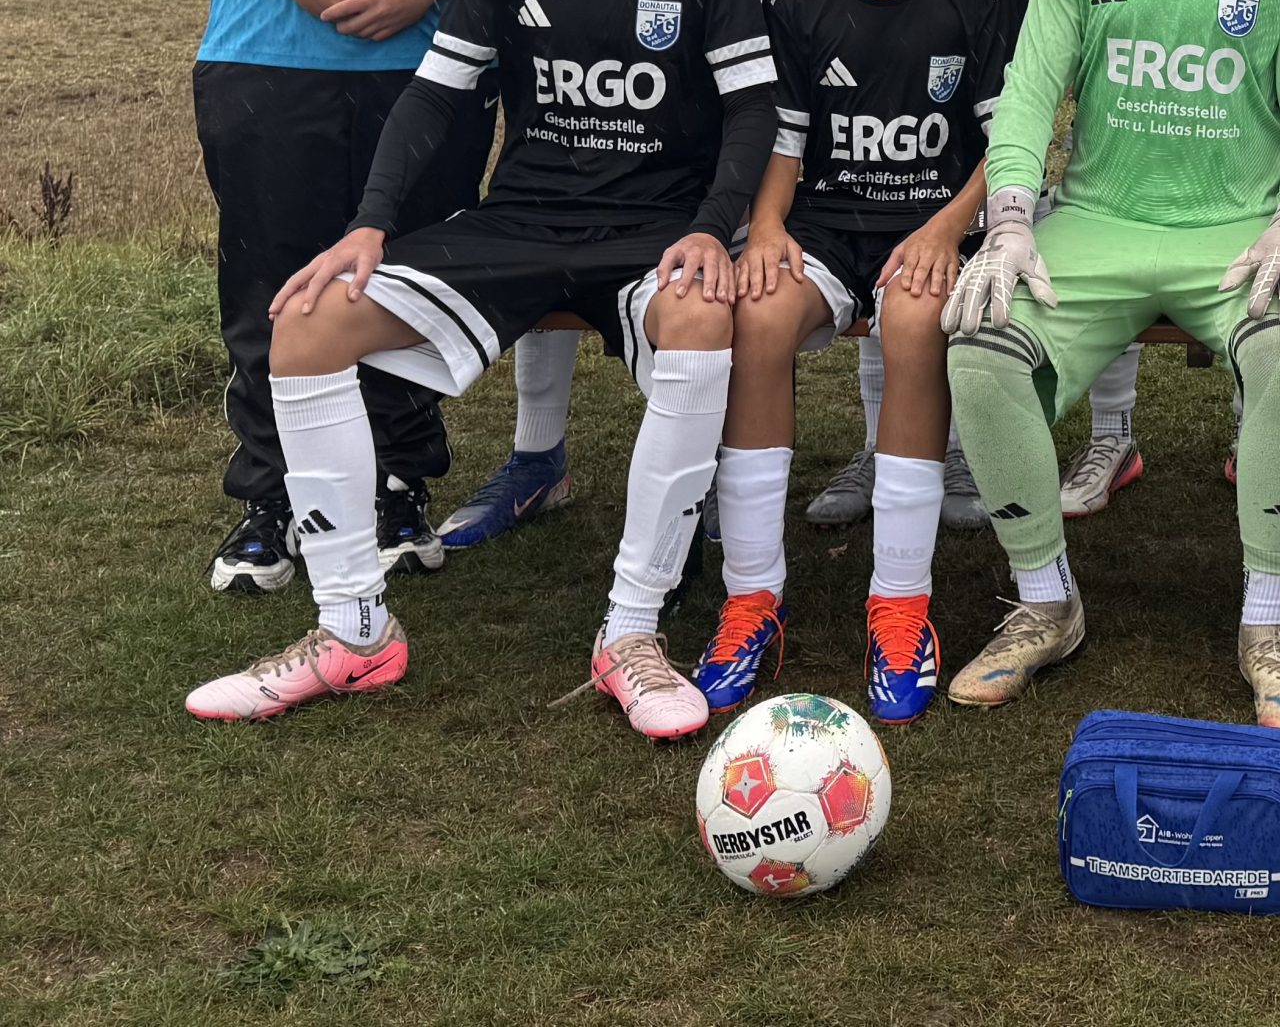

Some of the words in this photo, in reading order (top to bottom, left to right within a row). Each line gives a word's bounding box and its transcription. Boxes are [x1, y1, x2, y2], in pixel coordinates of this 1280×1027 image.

[639, 0, 680, 12] DONAUTAL
[1107, 37, 1246, 94] ERGO
[533, 55, 667, 110] ERGO
[1116, 97, 1228, 120] Geschäftsstelle
[526, 127, 559, 144] Marc
[574, 135, 614, 150] Lukas
[617, 137, 663, 154] Horsch
[830, 112, 949, 162] ERGO
[1150, 120, 1192, 137] Lukas
[1196, 124, 1240, 139] Horsch
[866, 186, 906, 201] Lukas
[909, 185, 952, 201] Horsch
[712, 810, 812, 854] DERBYSTAR
[1087, 856, 1270, 886] TEAMSPORTBEDARF.DE
